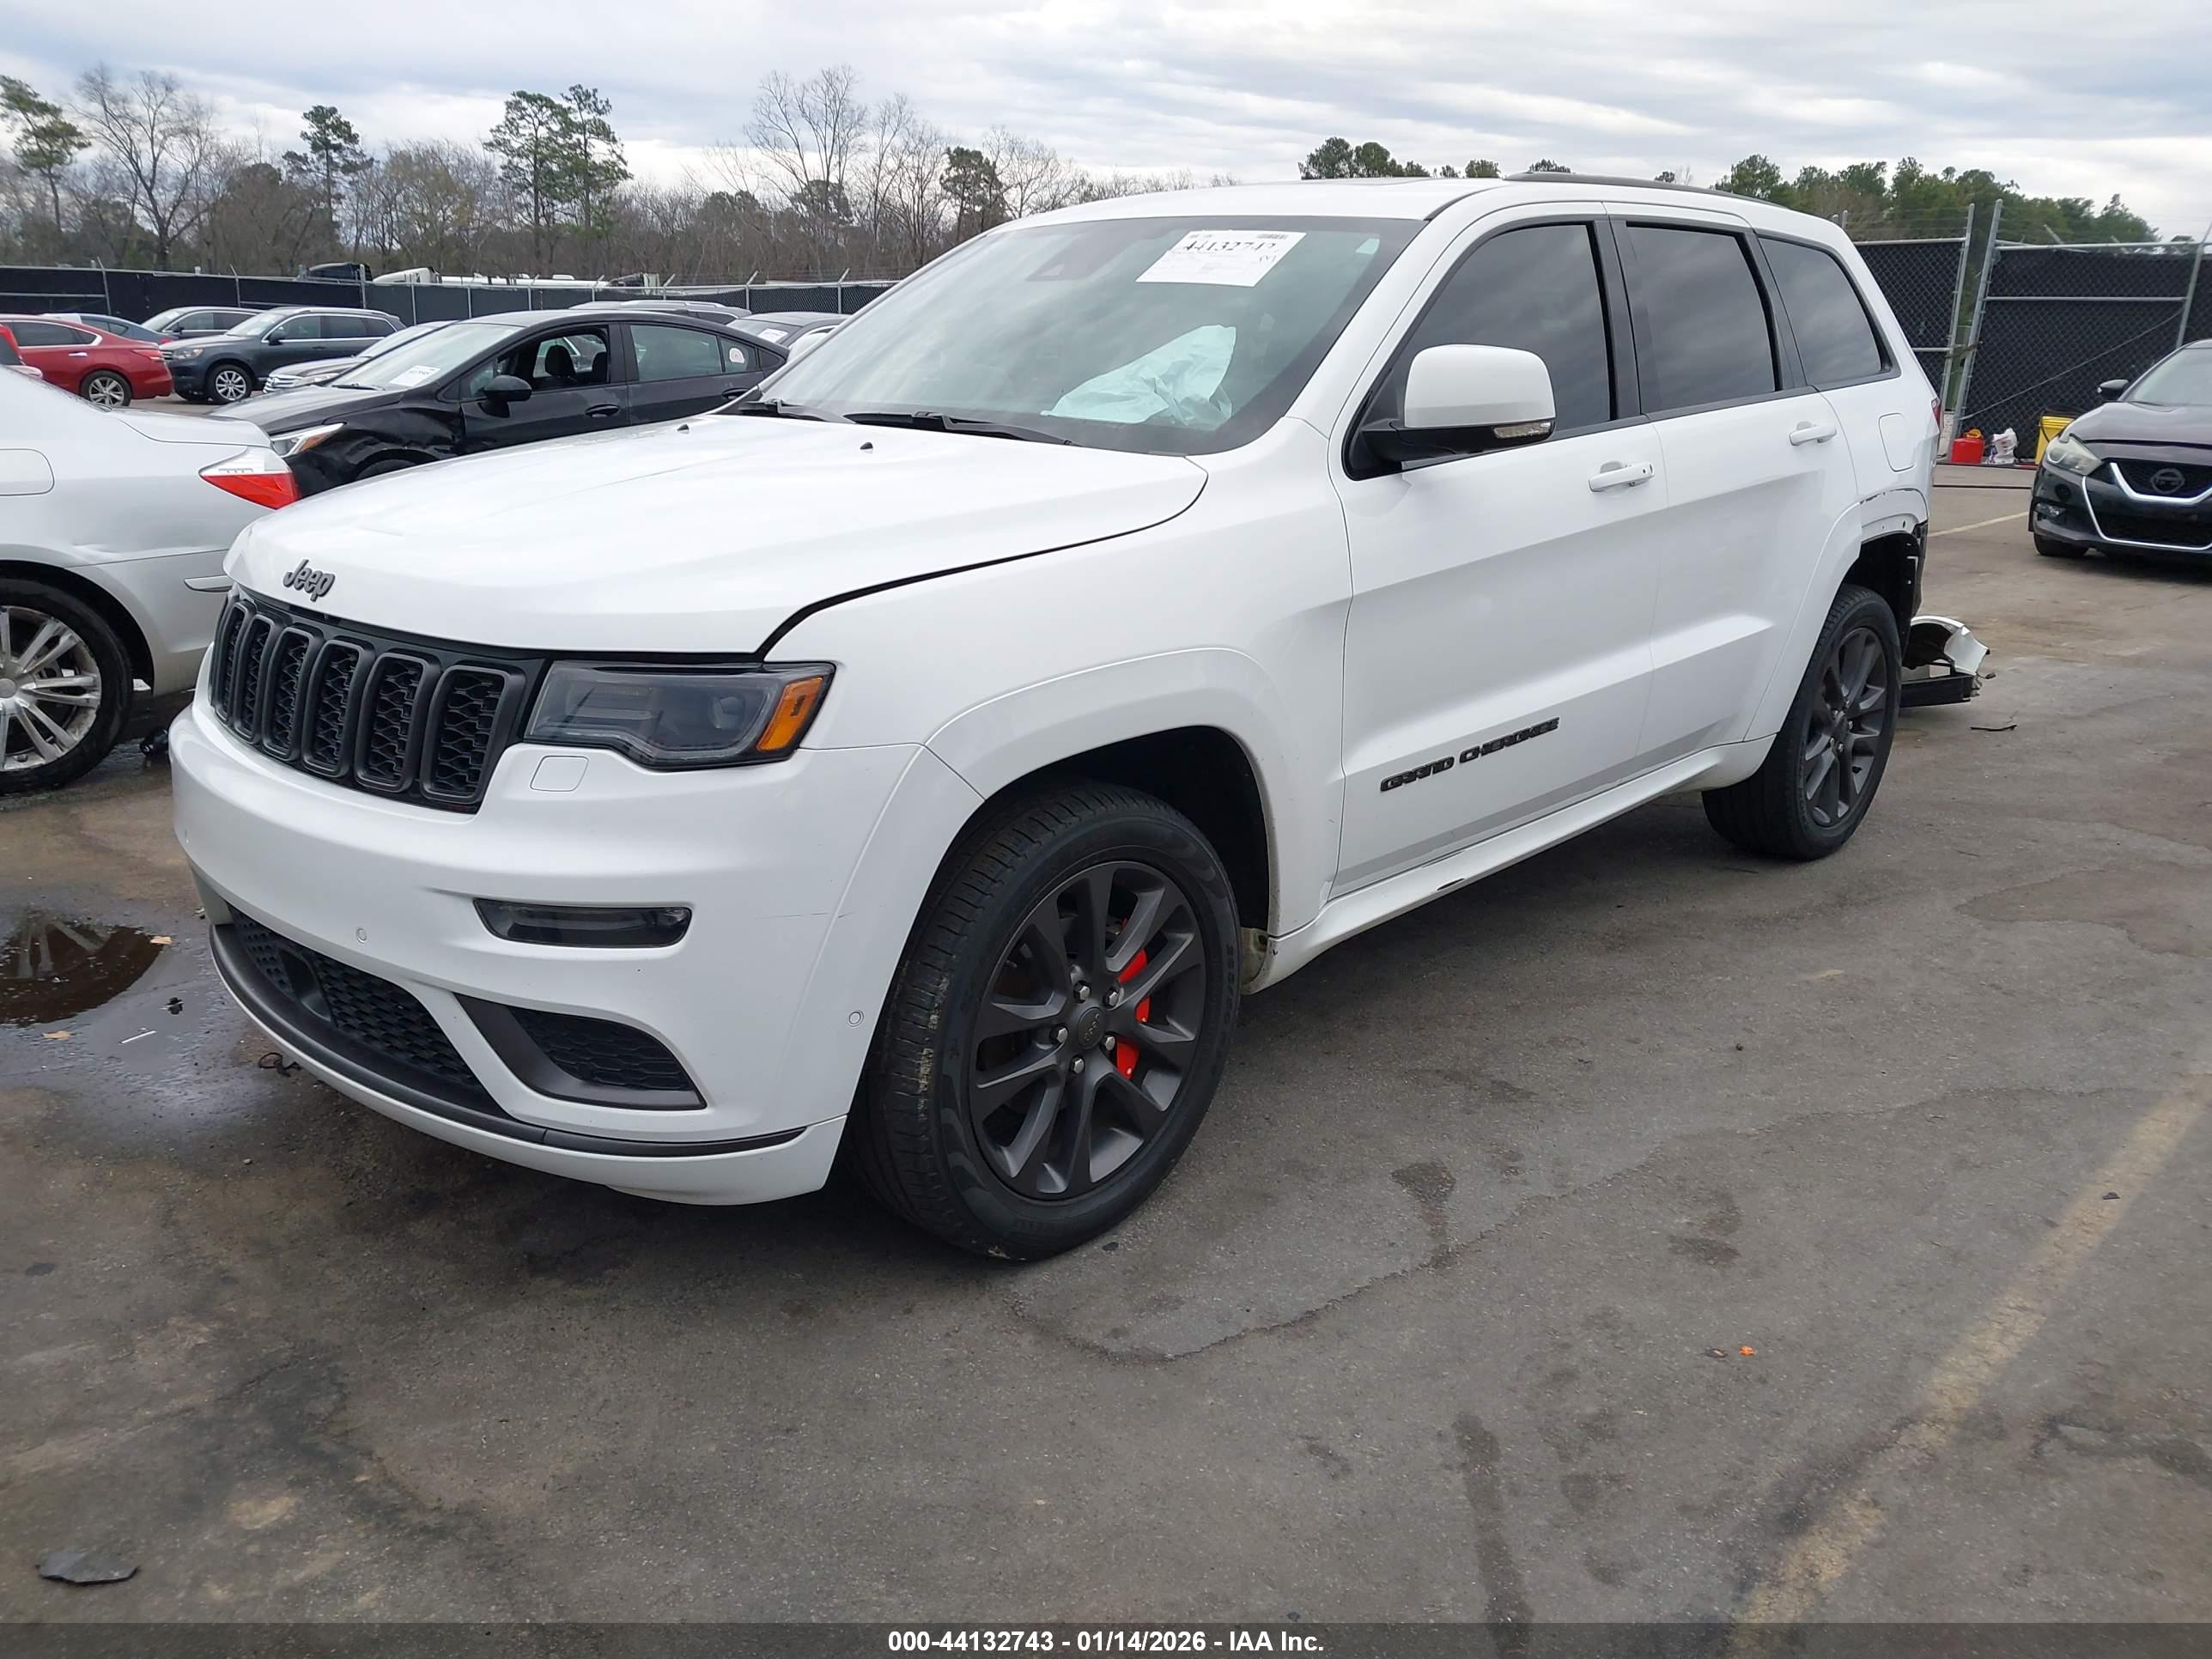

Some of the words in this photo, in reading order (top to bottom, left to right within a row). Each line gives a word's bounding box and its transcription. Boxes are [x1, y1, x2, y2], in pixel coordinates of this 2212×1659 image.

[283, 558, 336, 603] Jeep
[1380, 756, 1455, 792] GRAND
[1459, 716, 1560, 763] CHEROKEE
